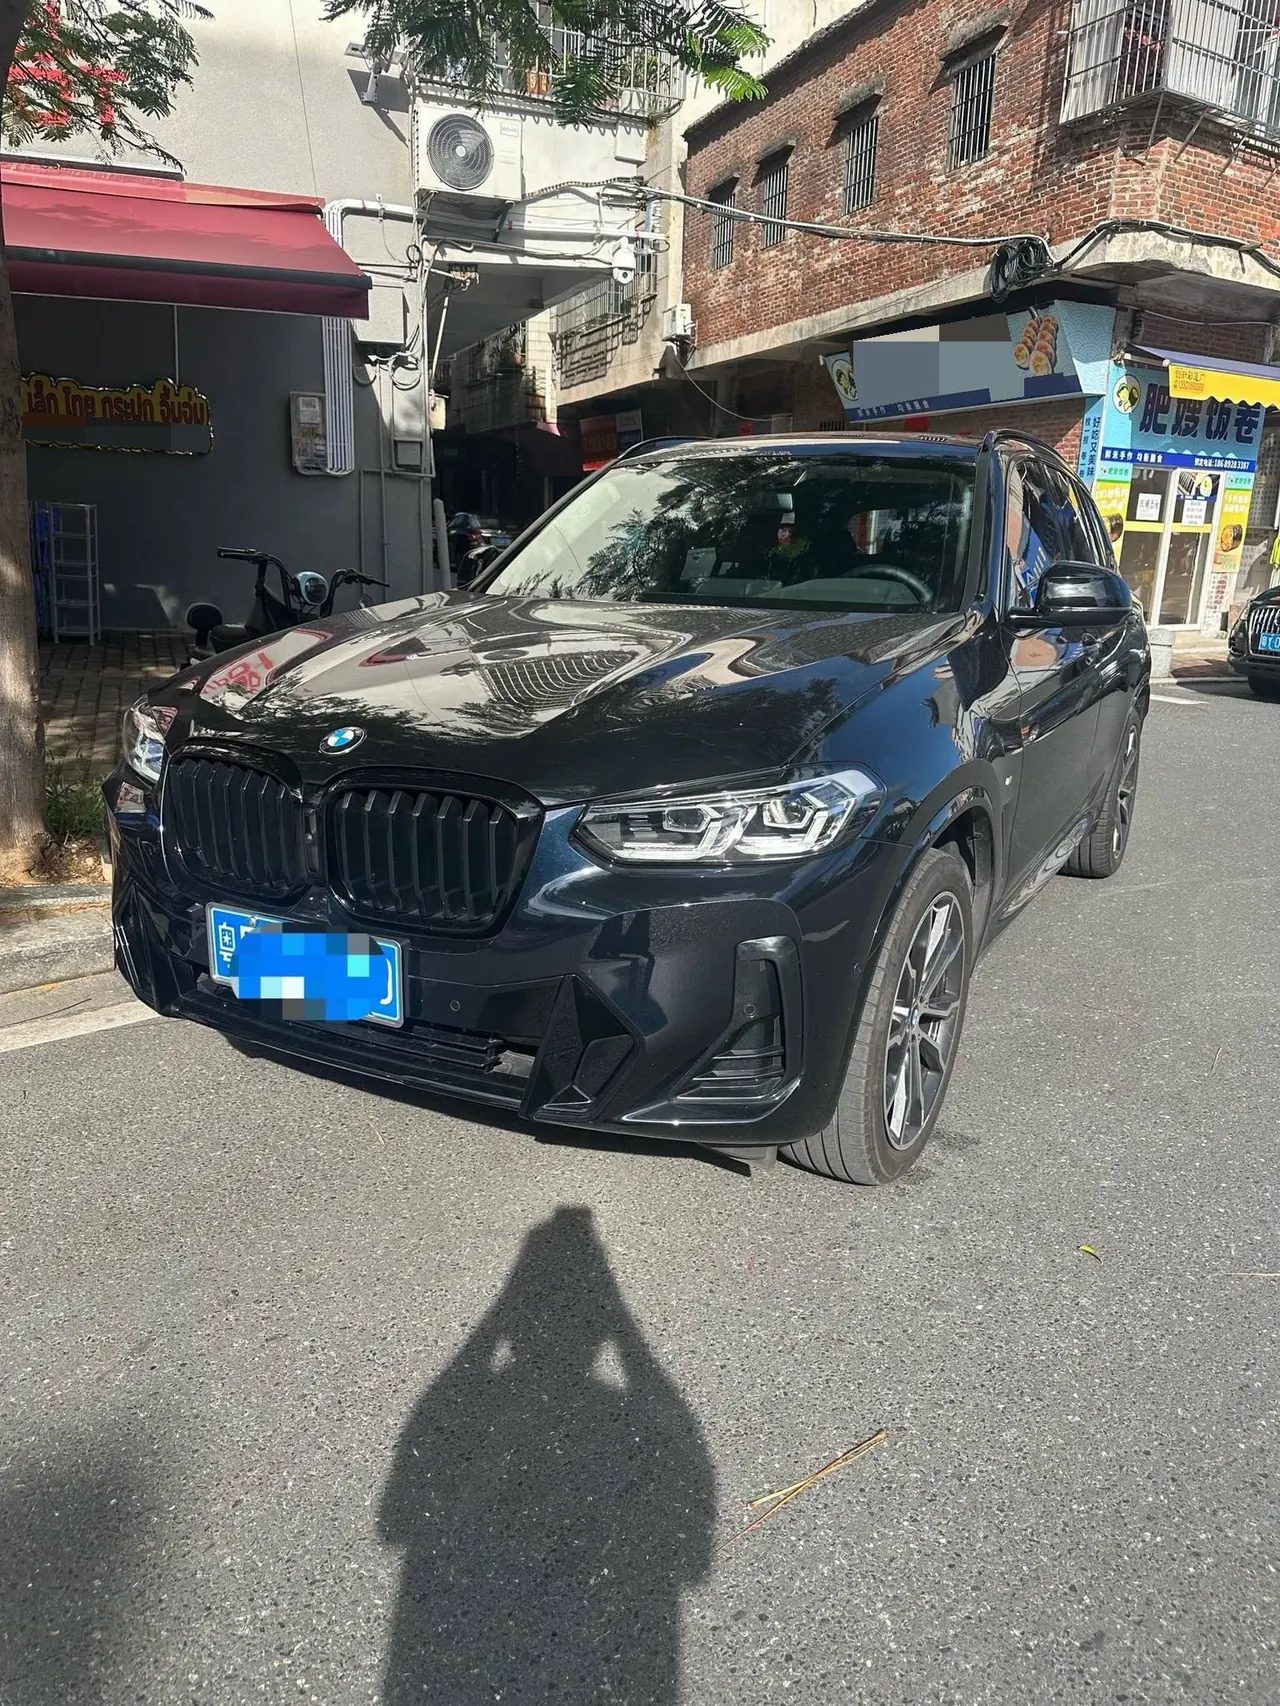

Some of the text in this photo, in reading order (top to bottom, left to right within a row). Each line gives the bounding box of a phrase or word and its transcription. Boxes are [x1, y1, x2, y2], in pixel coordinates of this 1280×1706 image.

[1139, 383, 1260, 444] 肥嫂饭卷
[1087, 416, 1101, 477] 好吃又美味
